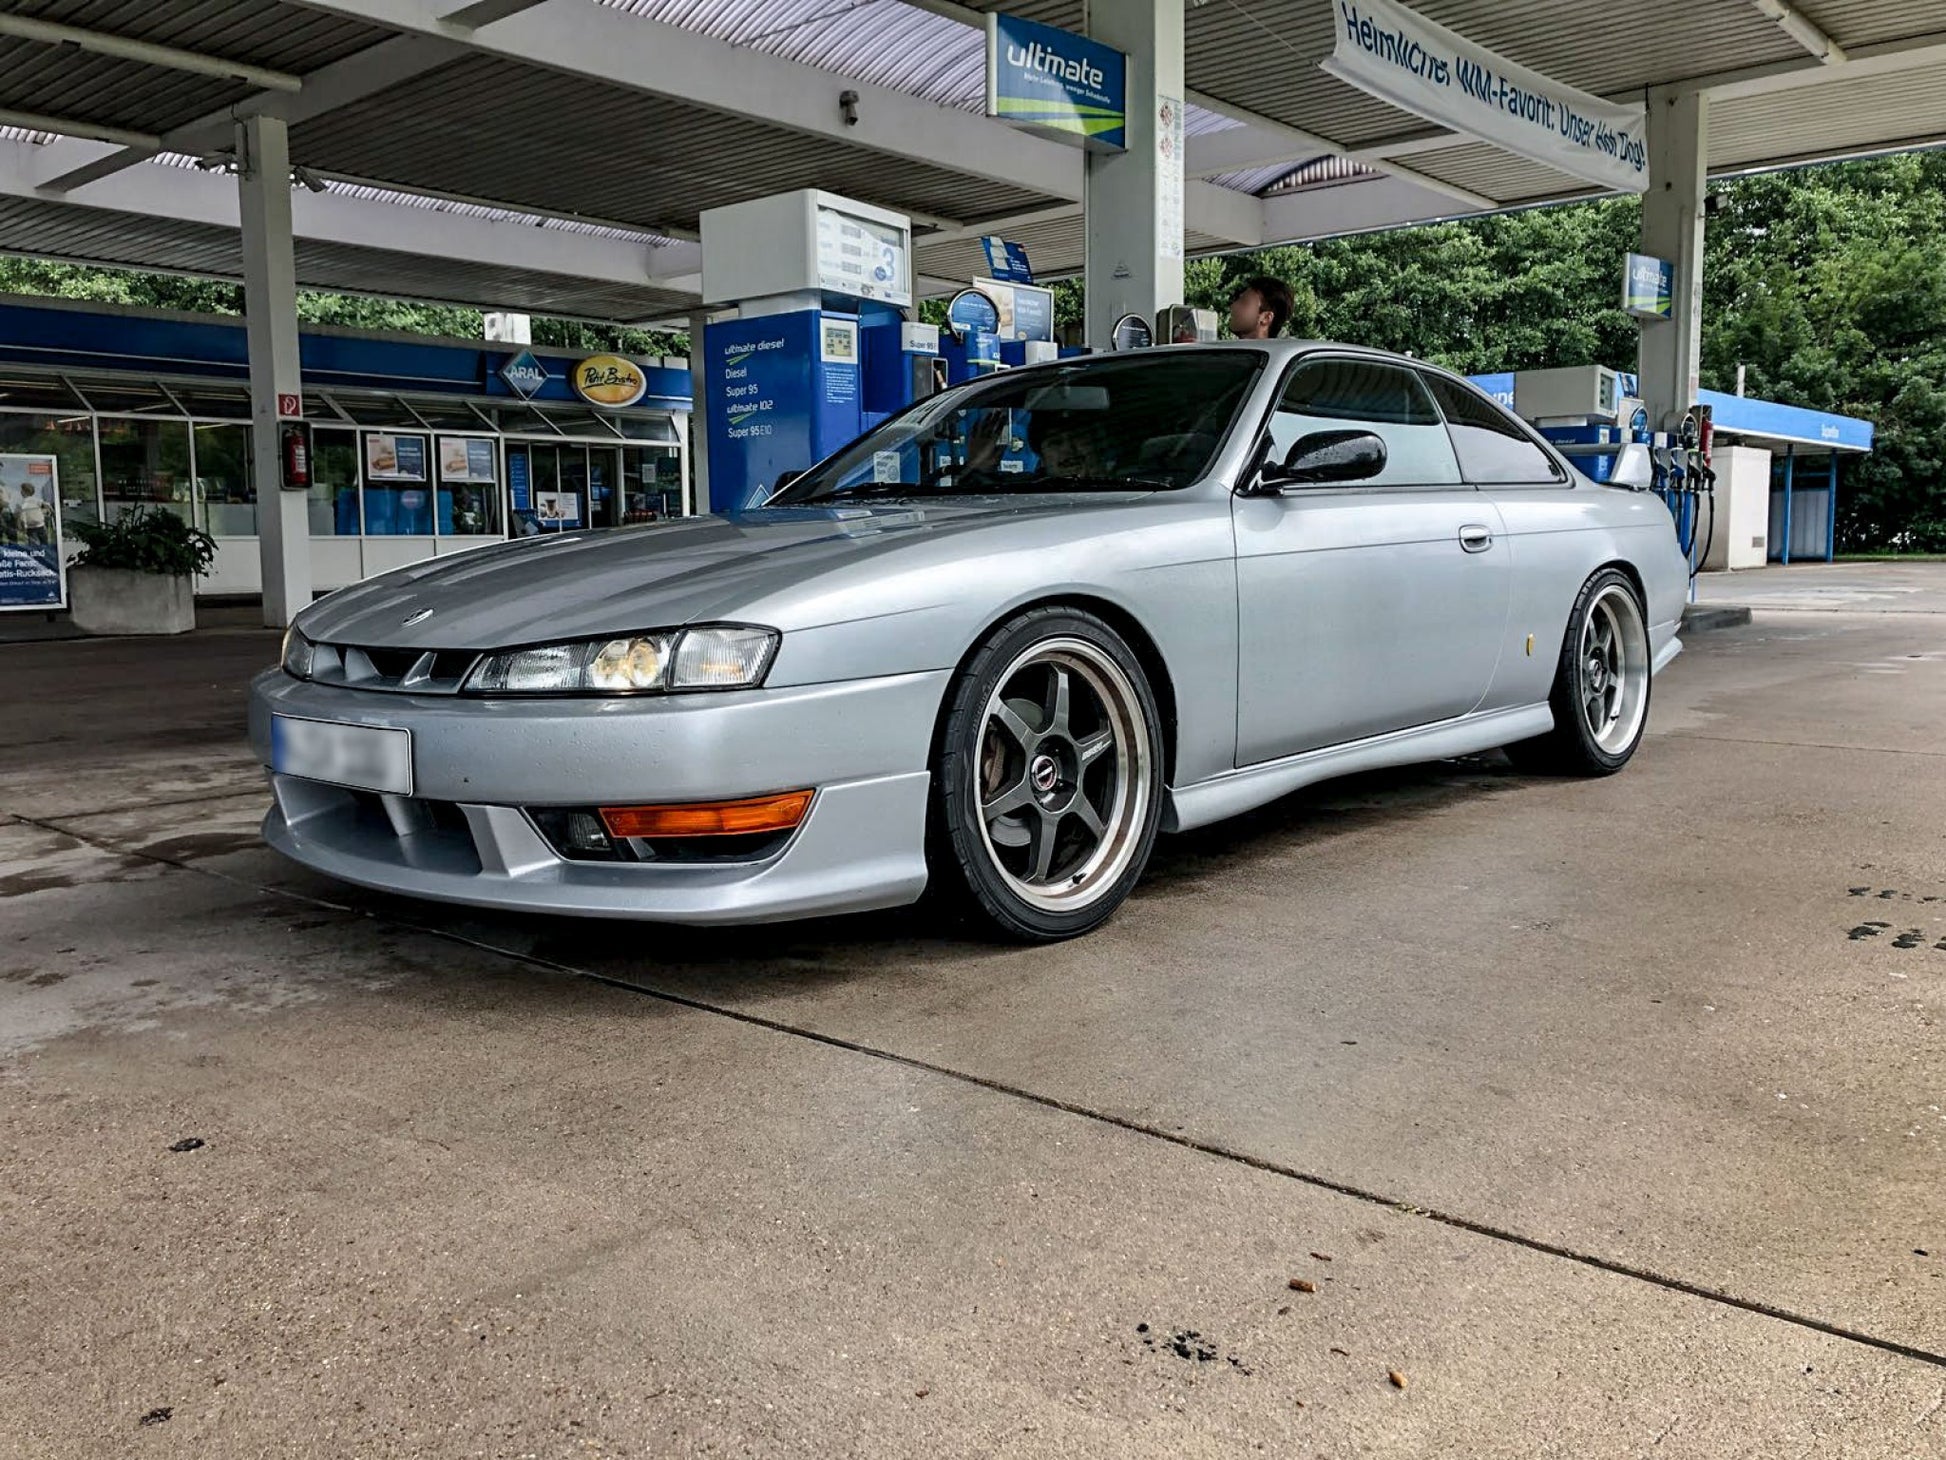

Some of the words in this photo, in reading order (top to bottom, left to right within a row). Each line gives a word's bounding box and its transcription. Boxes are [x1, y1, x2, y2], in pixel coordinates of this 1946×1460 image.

[1007, 41, 1104, 89] ultimate
[1456, 56, 1556, 131] WM-Favorit:
[1559, 101, 1596, 148] Unser
[1618, 131, 1646, 172] Dog!
[1632, 265, 1668, 288] ultimate
[724, 342, 756, 355] ultimate
[757, 337, 785, 351] diesel
[909, 340, 925, 349] Super
[510, 365, 544, 380] ARAL
[604, 366, 639, 385] Bistro
[725, 366, 748, 380] Diesel
[726, 385, 747, 398] Super
[748, 383, 759, 395] 95
[726, 402, 759, 414] ultimate
[759, 399, 774, 411] 102
[728, 426, 748, 439] Super
[30, 548, 46, 558] und
